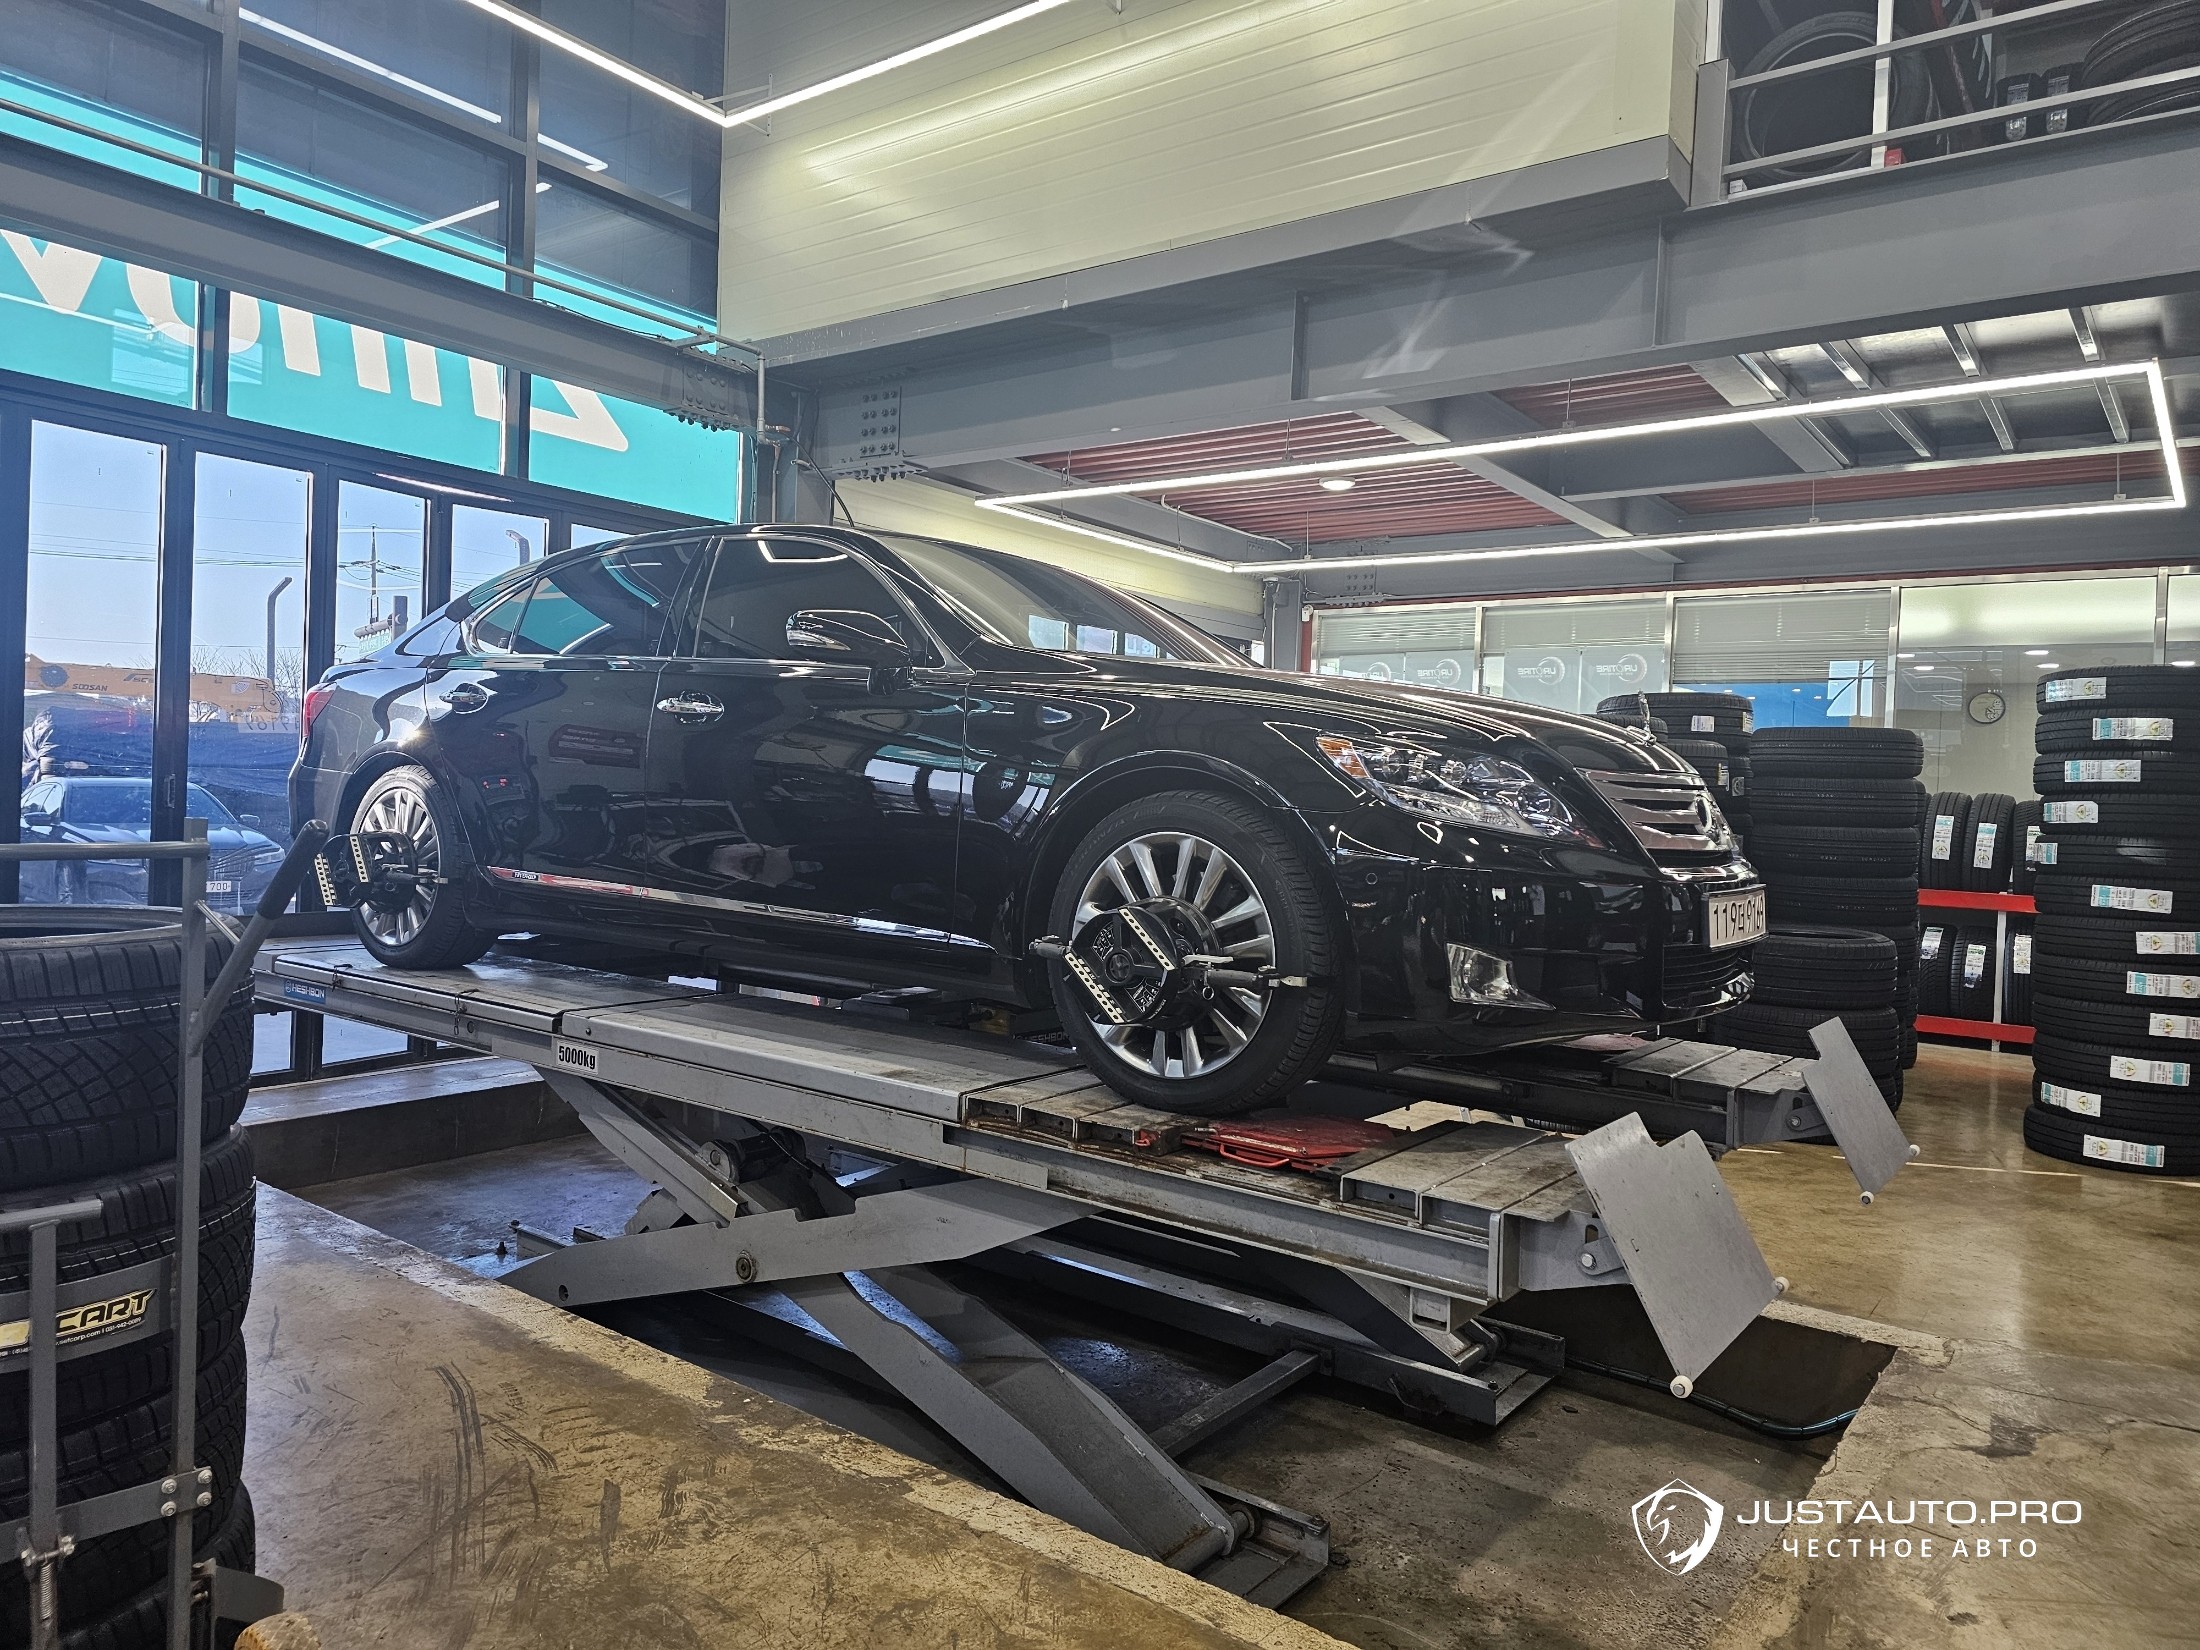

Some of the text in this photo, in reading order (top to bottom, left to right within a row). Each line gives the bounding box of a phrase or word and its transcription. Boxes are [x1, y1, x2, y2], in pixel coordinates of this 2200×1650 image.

[72, 683, 108, 691] SOOSAN
[210, 882, 228, 891] 700
[291, 983, 325, 999] HESHBON
[558, 1045, 596, 1070] 5000kg
